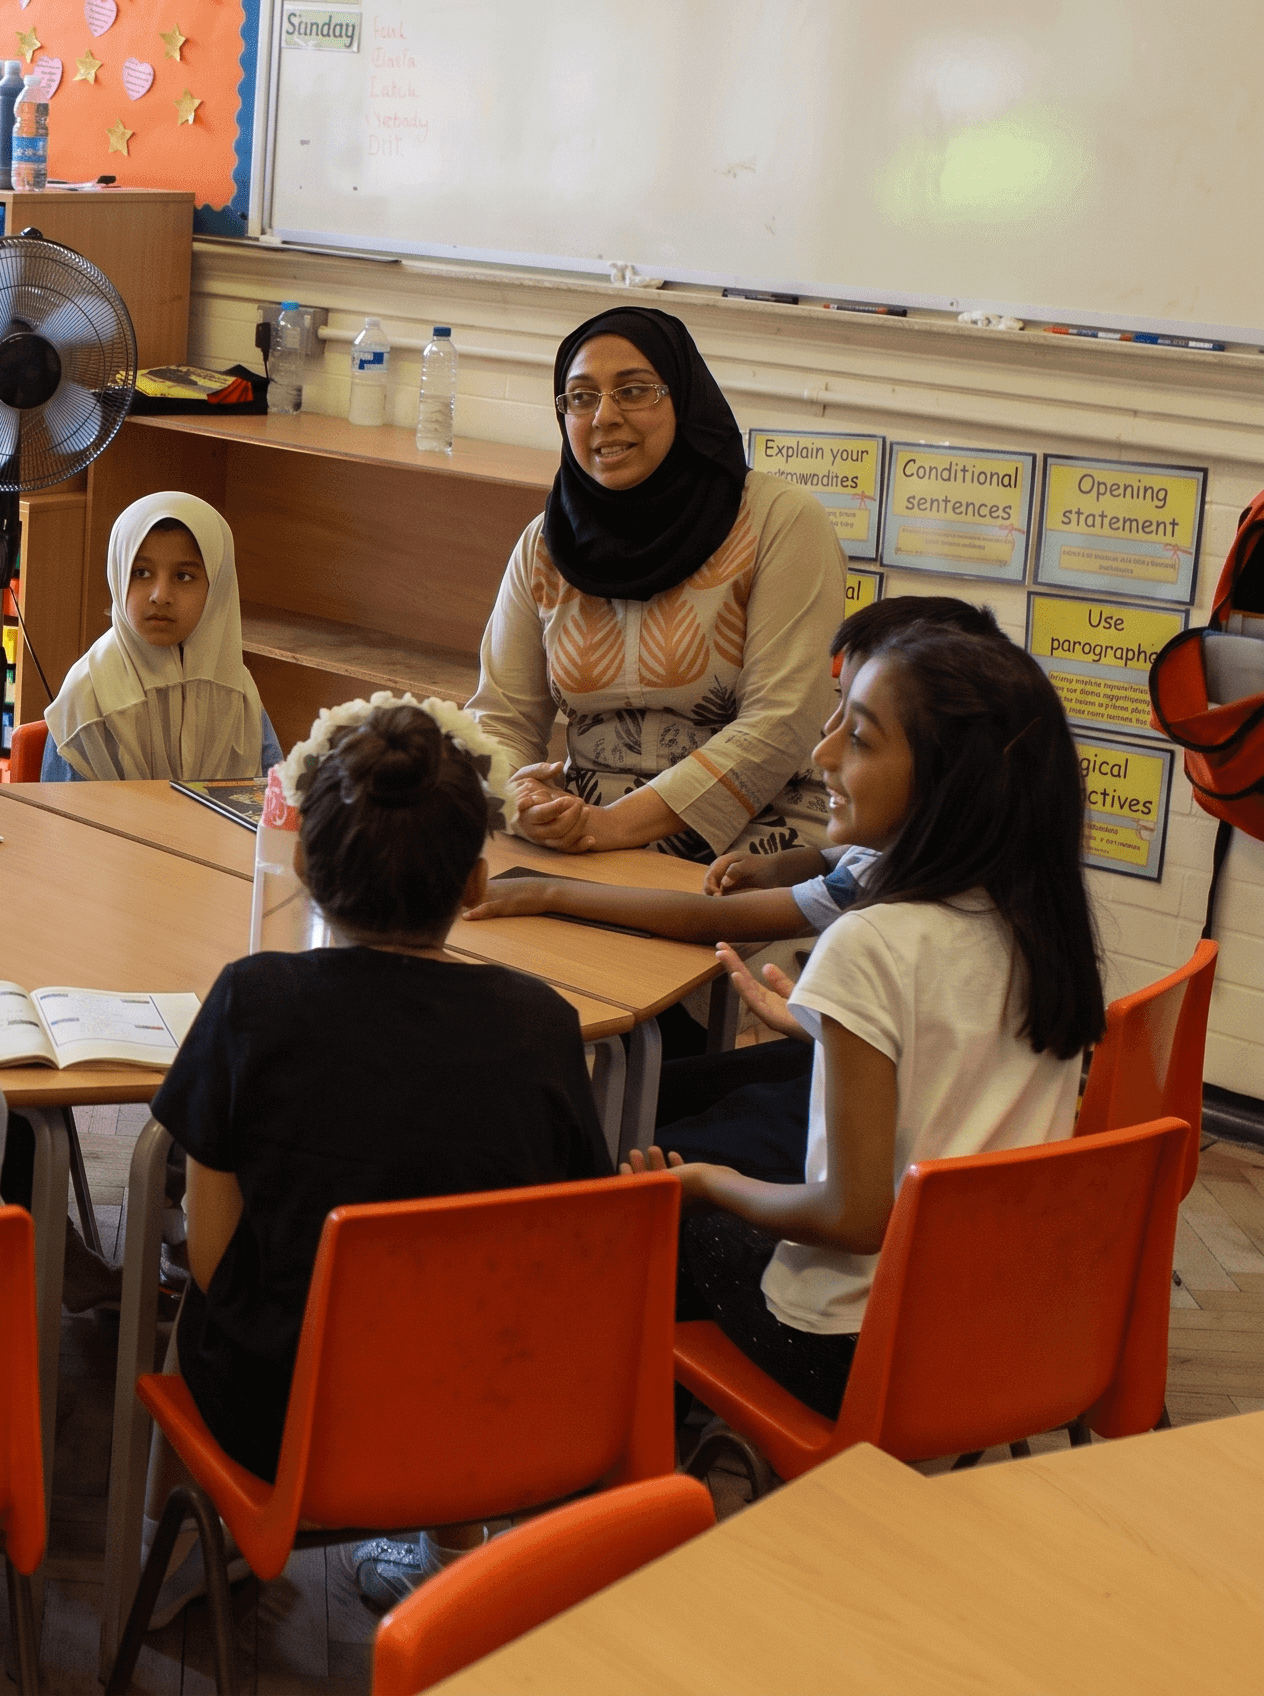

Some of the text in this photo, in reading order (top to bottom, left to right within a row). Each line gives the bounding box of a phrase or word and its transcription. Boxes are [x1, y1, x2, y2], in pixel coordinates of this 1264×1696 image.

[286, 12, 356, 48] Sunday
[764, 438, 869, 466] Explain your
[902, 458, 1019, 489] Conditional
[1077, 473, 1169, 509] Opening
[905, 494, 1012, 521] sentences
[1061, 507, 1179, 538] statement
[1088, 608, 1125, 632] Use
